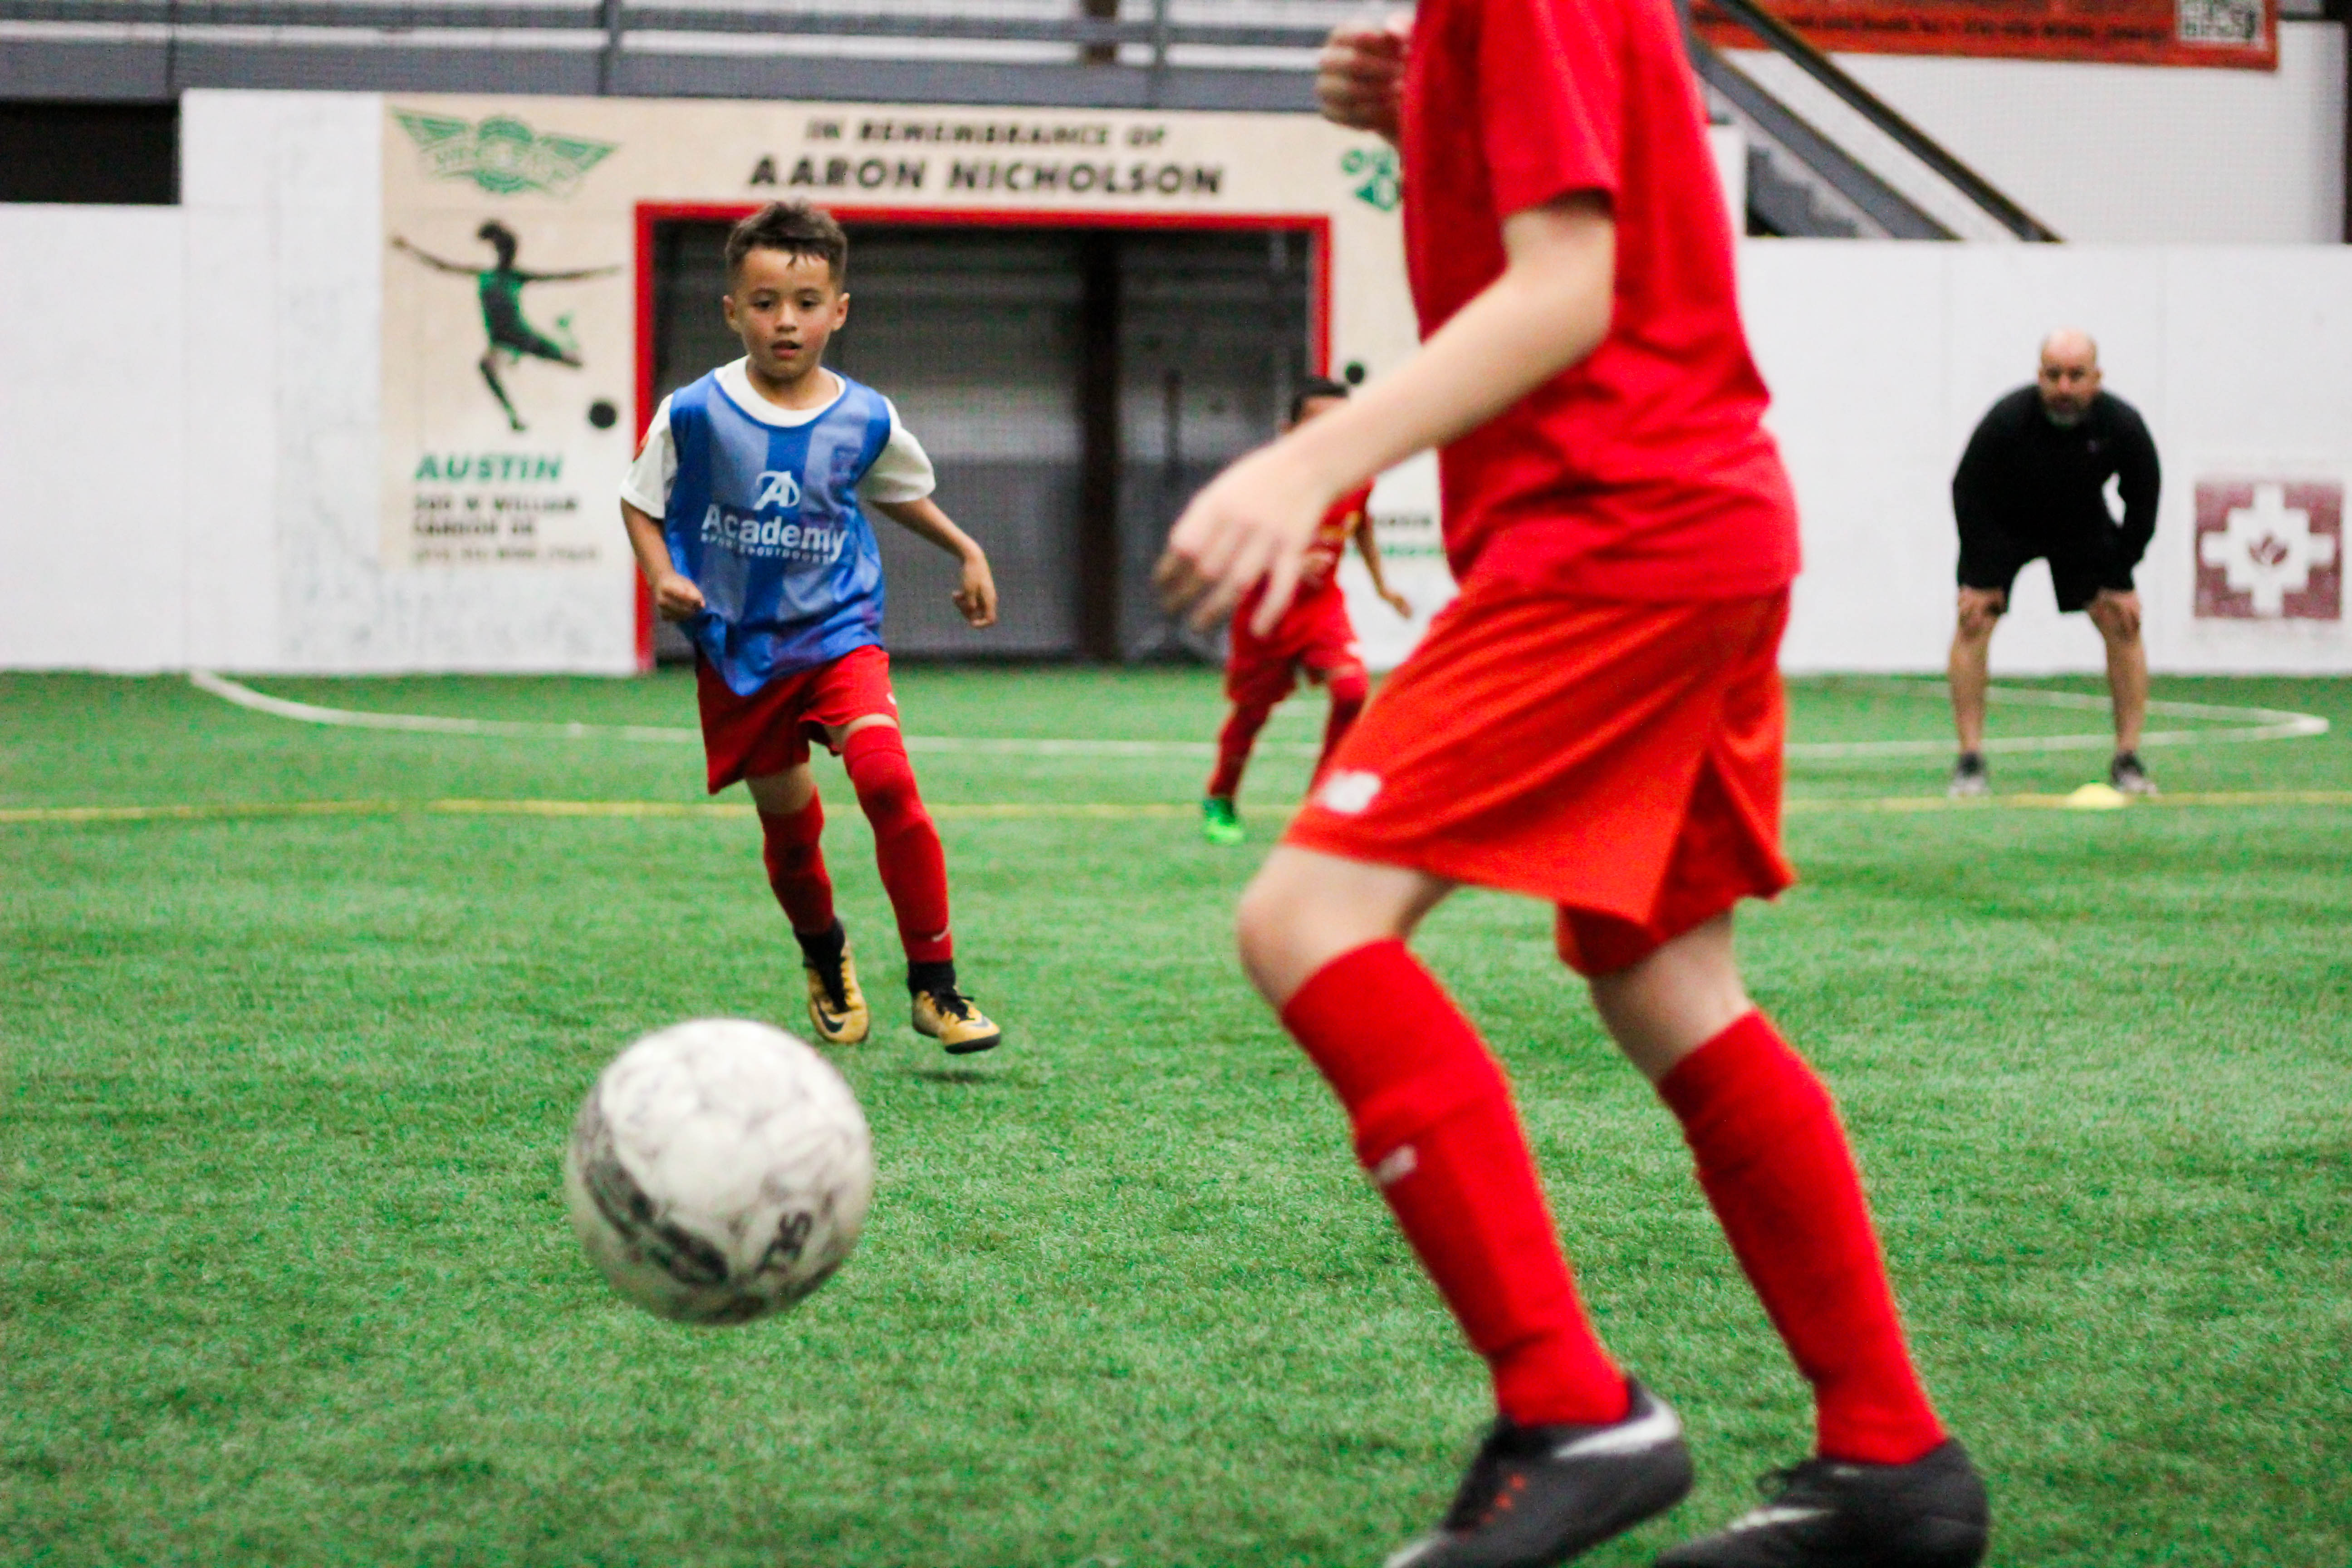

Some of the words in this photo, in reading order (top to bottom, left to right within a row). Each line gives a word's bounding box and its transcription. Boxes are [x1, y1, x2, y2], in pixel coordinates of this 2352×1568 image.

[858, 120, 1108, 146] REMEMBRANCE
[749, 155, 926, 190] AARON
[948, 159, 1224, 194] NICHOLSON
[415, 453, 564, 482] AUSTIN
[701, 503, 848, 562] Academy
